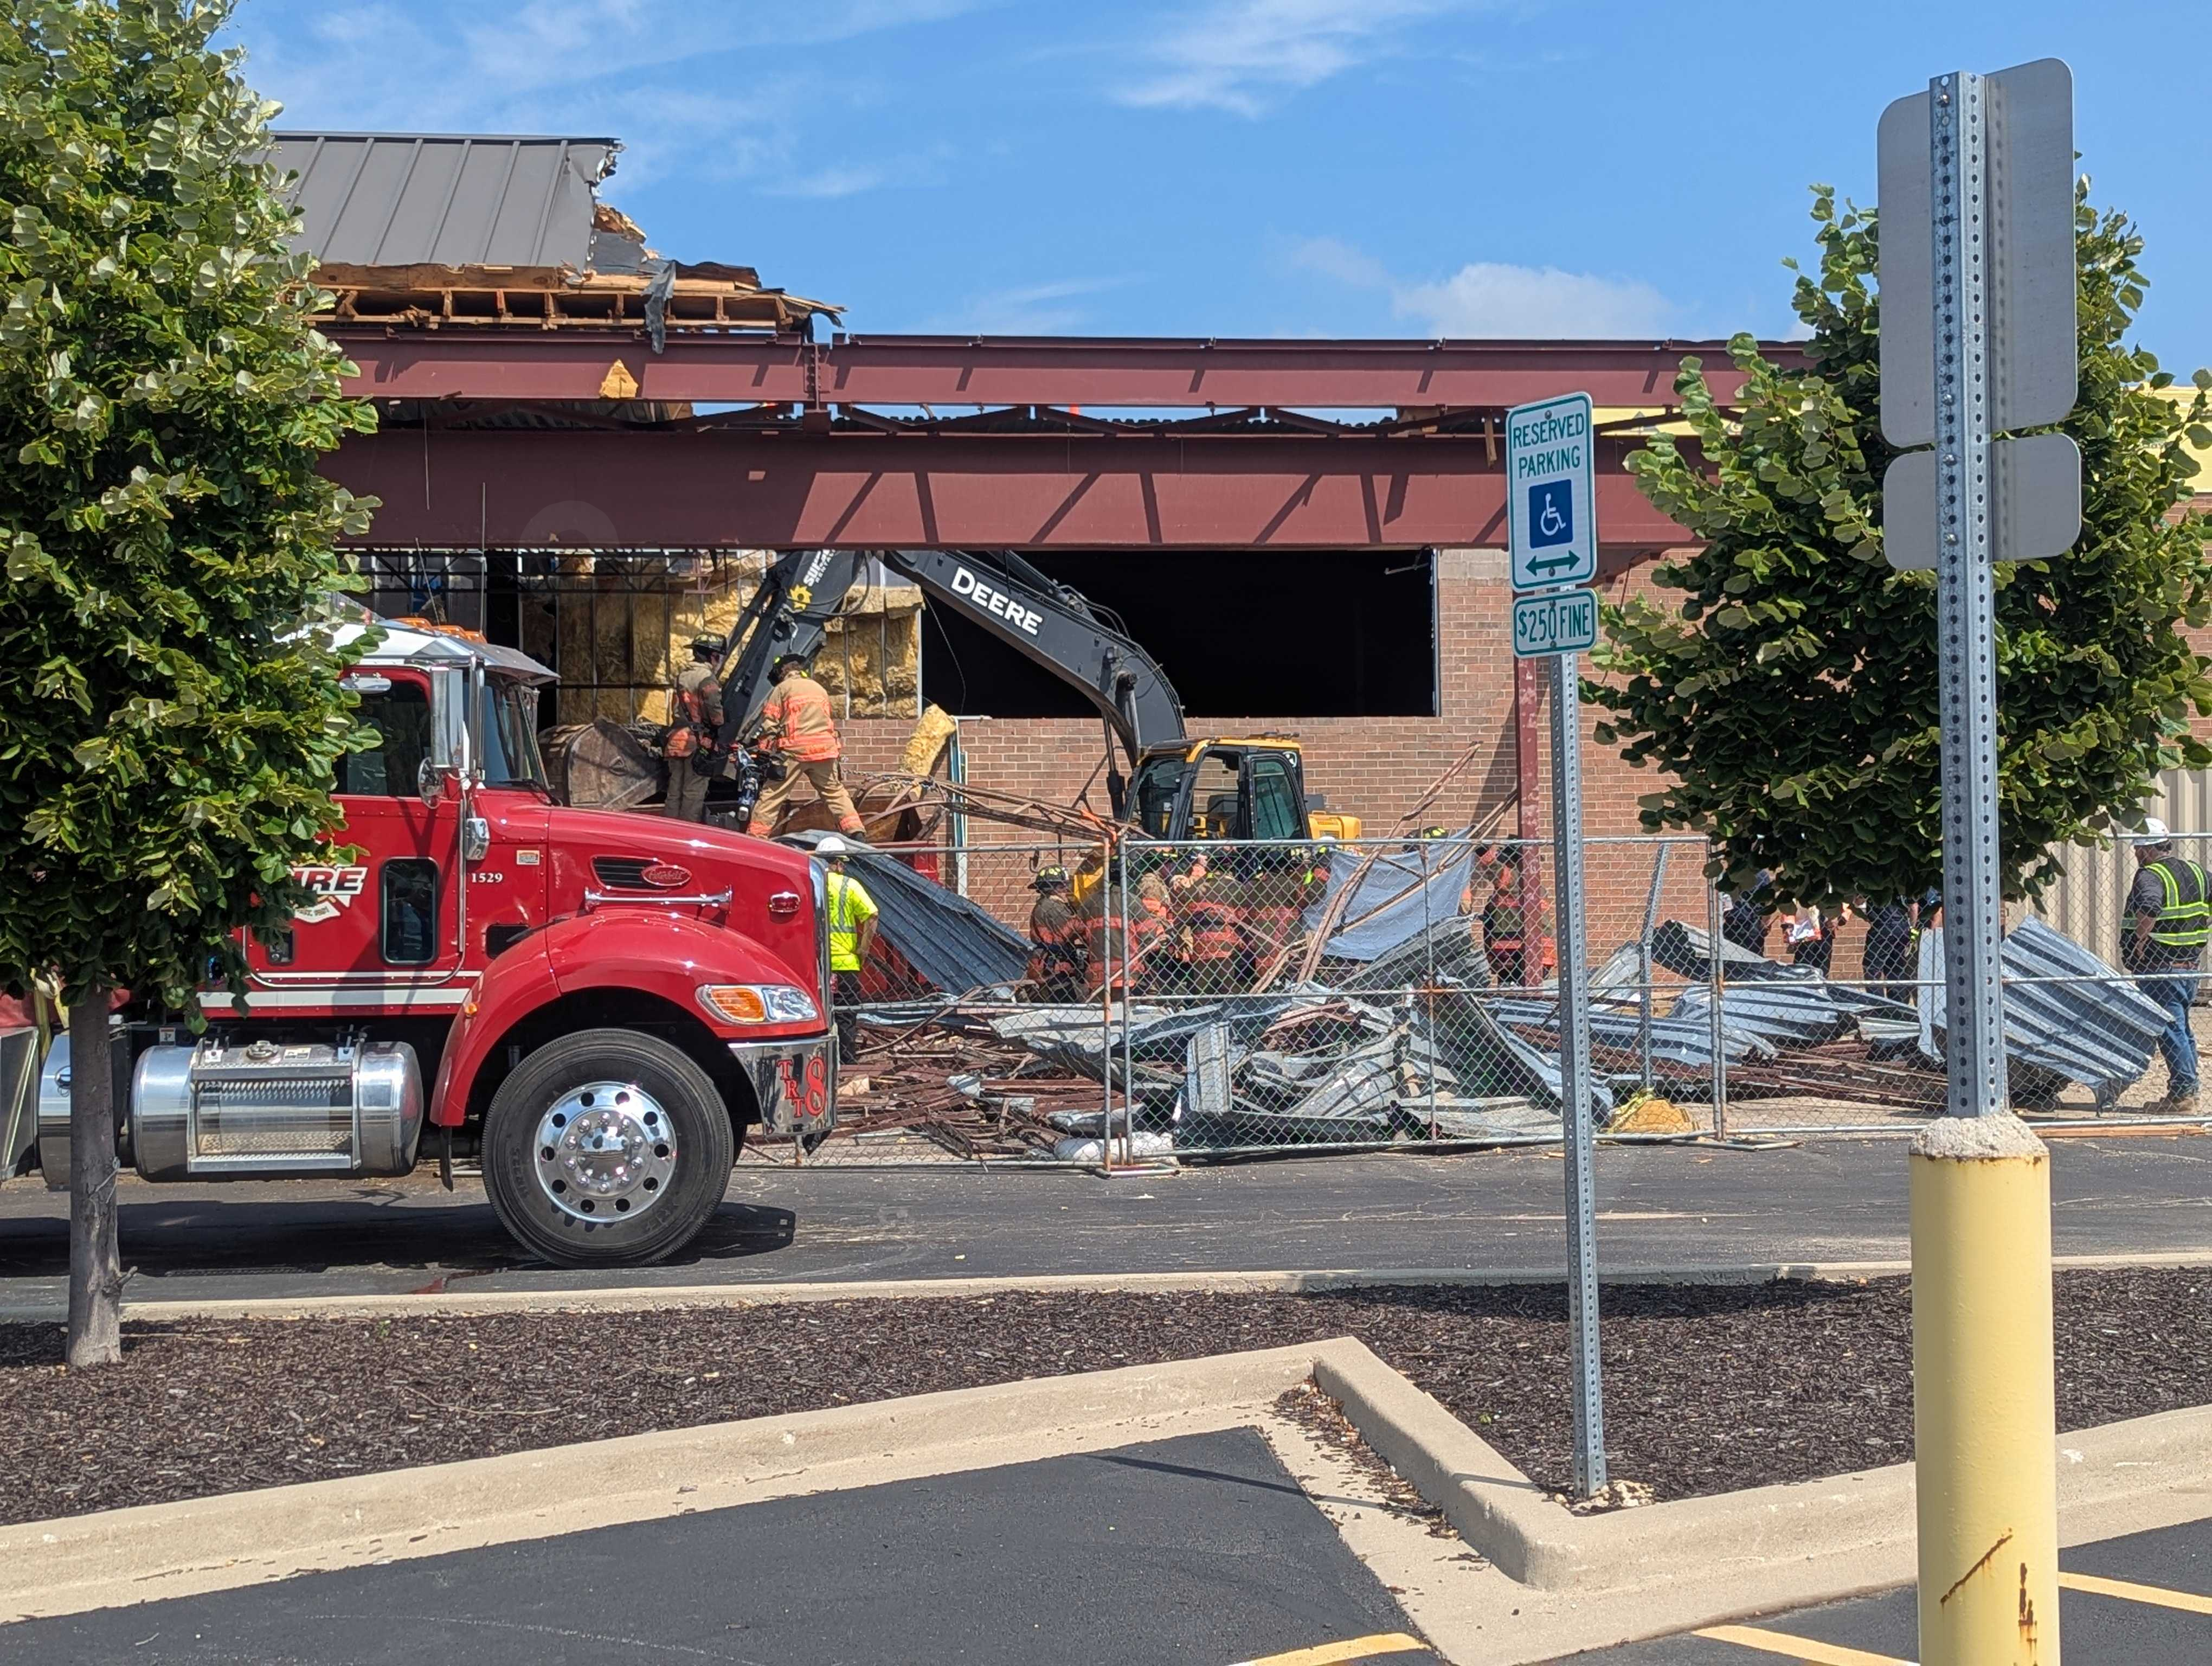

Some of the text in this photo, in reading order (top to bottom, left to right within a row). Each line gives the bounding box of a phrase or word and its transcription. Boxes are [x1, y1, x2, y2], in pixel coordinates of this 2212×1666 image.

[1513, 413, 1584, 449] RESERVED
[1519, 445, 1580, 479] PARKING
[951, 566, 1043, 636] DEERE
[1519, 603, 1591, 643] $250 FINE
[471, 872, 503, 883] 1529
[806, 1056, 827, 1116] 8
